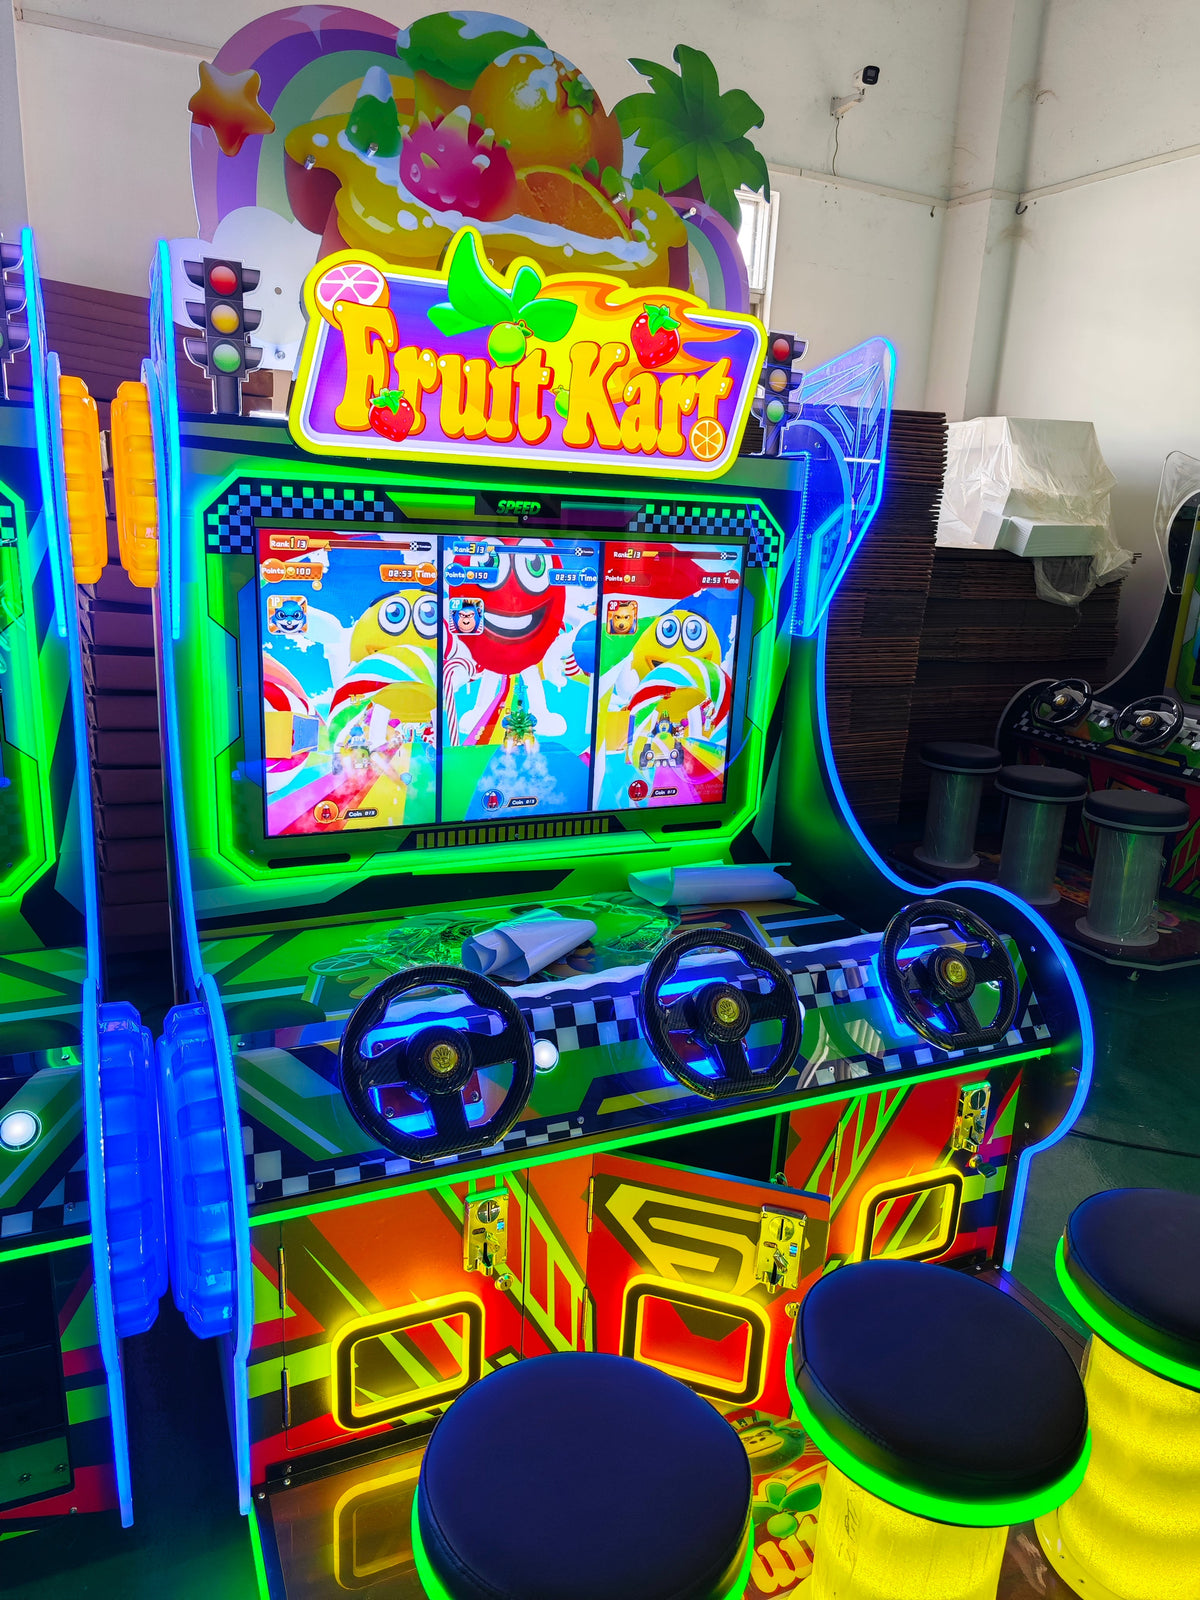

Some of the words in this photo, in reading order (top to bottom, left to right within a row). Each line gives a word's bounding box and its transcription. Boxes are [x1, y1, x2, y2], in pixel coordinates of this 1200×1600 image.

[333, 299, 555, 445] Fruit
[562, 341, 735, 459] Kart
[496, 499, 541, 515] SPEED
[270, 539, 290, 548] Rank
[261, 566, 285, 575] Points
[296, 567, 311, 576] 100
[388, 569, 413, 578] 02:53
[416, 569, 436, 579] Time
[445, 571, 465, 579] Points
[474, 571, 488, 580] 150
[555, 573, 577, 582] 02:53
[580, 573, 597, 582] Time
[605, 574, 623, 582] Points
[702, 576, 721, 584] 02:53
[723, 577, 739, 585] Time
[270, 597, 281, 608] 1P
[451, 600, 460, 610] 2P
[609, 601, 618, 611] 3P
